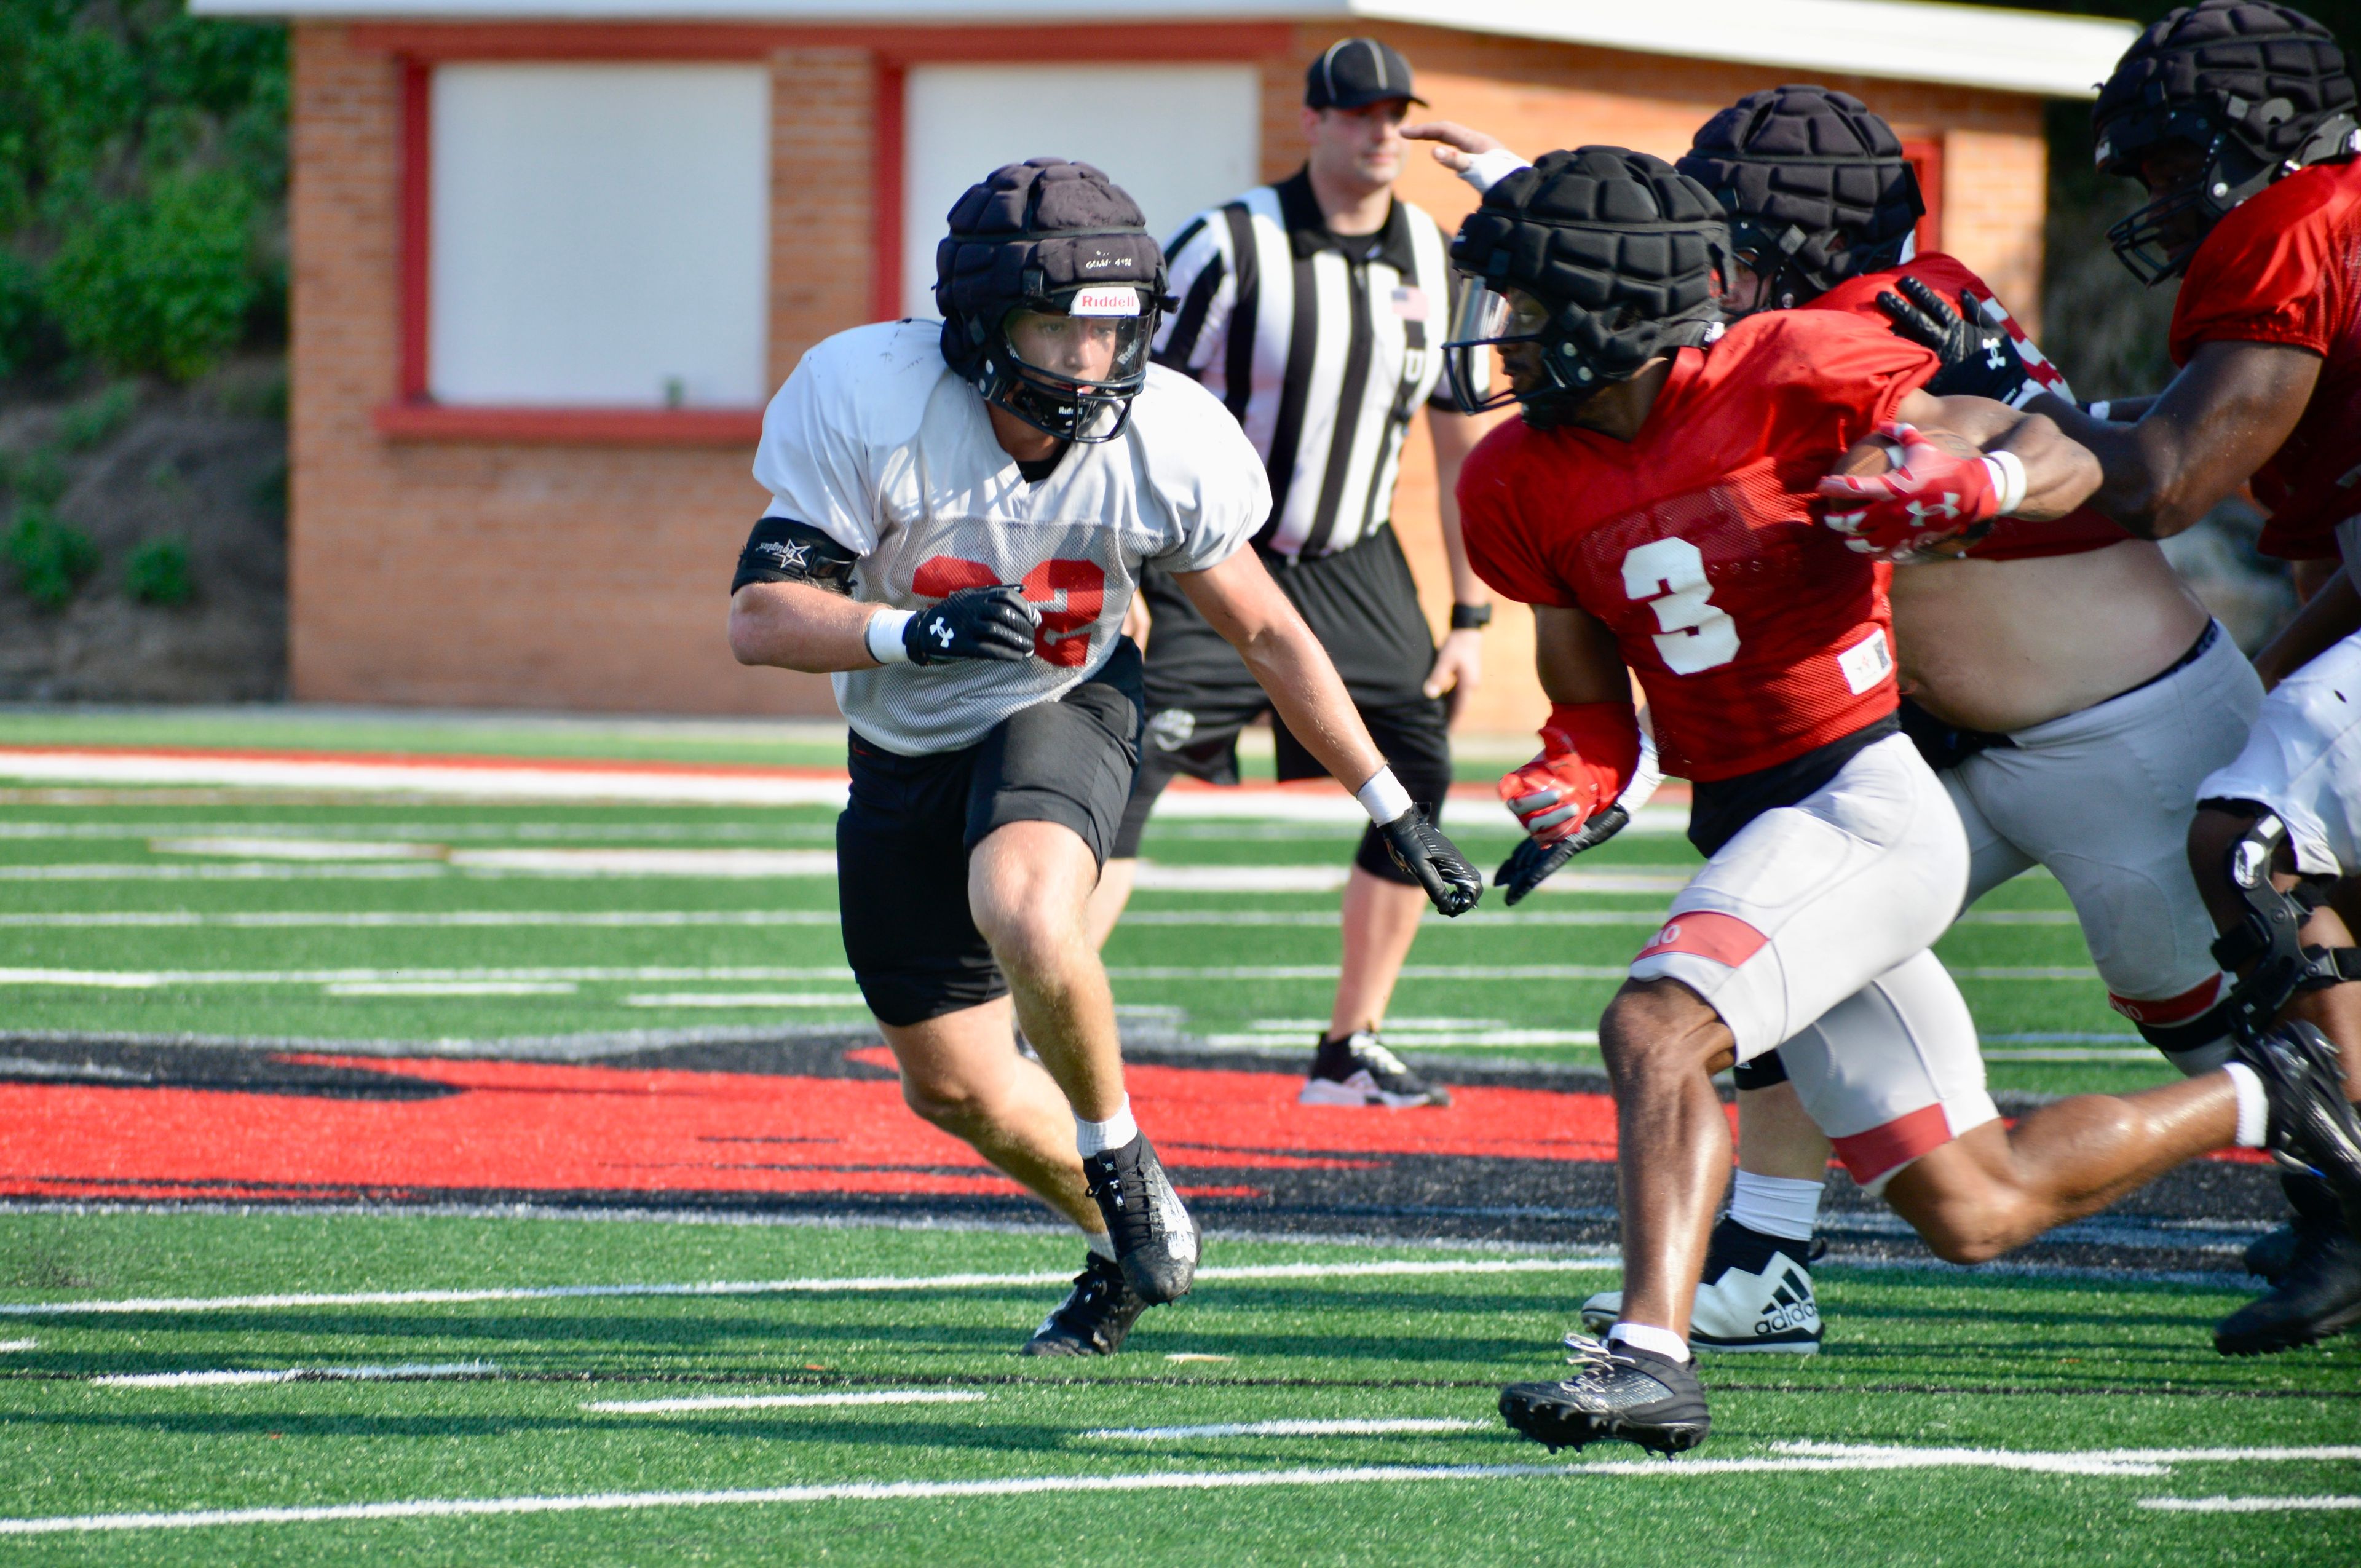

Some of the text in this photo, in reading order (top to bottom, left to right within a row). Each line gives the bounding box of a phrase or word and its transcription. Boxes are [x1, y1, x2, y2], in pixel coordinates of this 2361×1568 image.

[1082, 296, 1134, 307] Riddell
[759, 542, 797, 559] Douglas
[1621, 536, 1741, 675] 3
